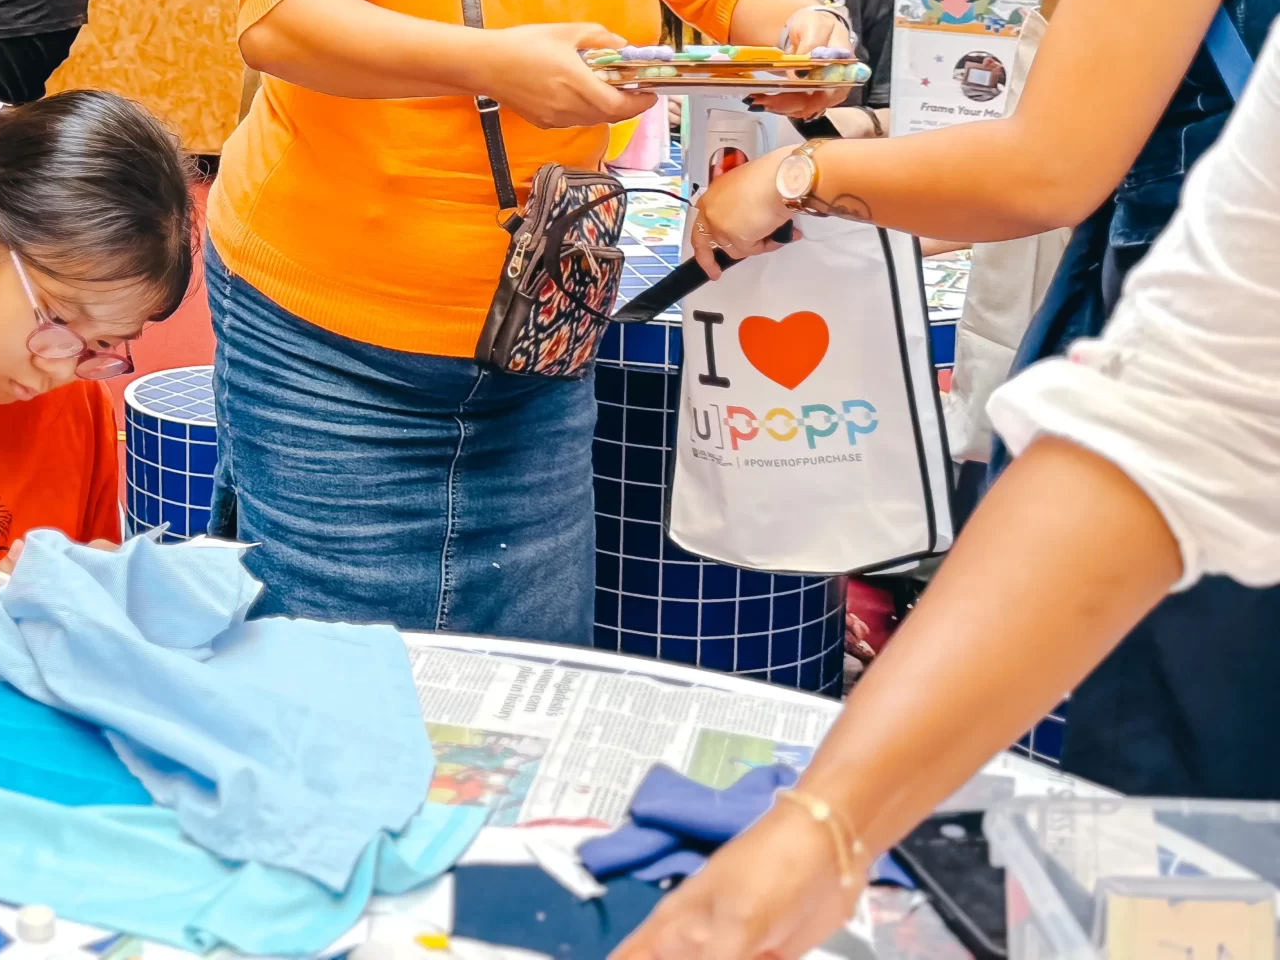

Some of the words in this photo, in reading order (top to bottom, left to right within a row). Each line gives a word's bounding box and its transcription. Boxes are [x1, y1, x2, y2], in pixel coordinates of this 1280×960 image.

[920, 102, 955, 114] Frame
[957, 106, 982, 116] Your
[693, 310, 730, 388] I
[744, 453, 863, 468] #POWEROFPURCHASE
[515, 665, 536, 686] place
[532, 668, 554, 694] women
[524, 694, 542, 713] earn
[546, 669, 581, 717] Bangladesh's
[493, 693, 525, 721] history
